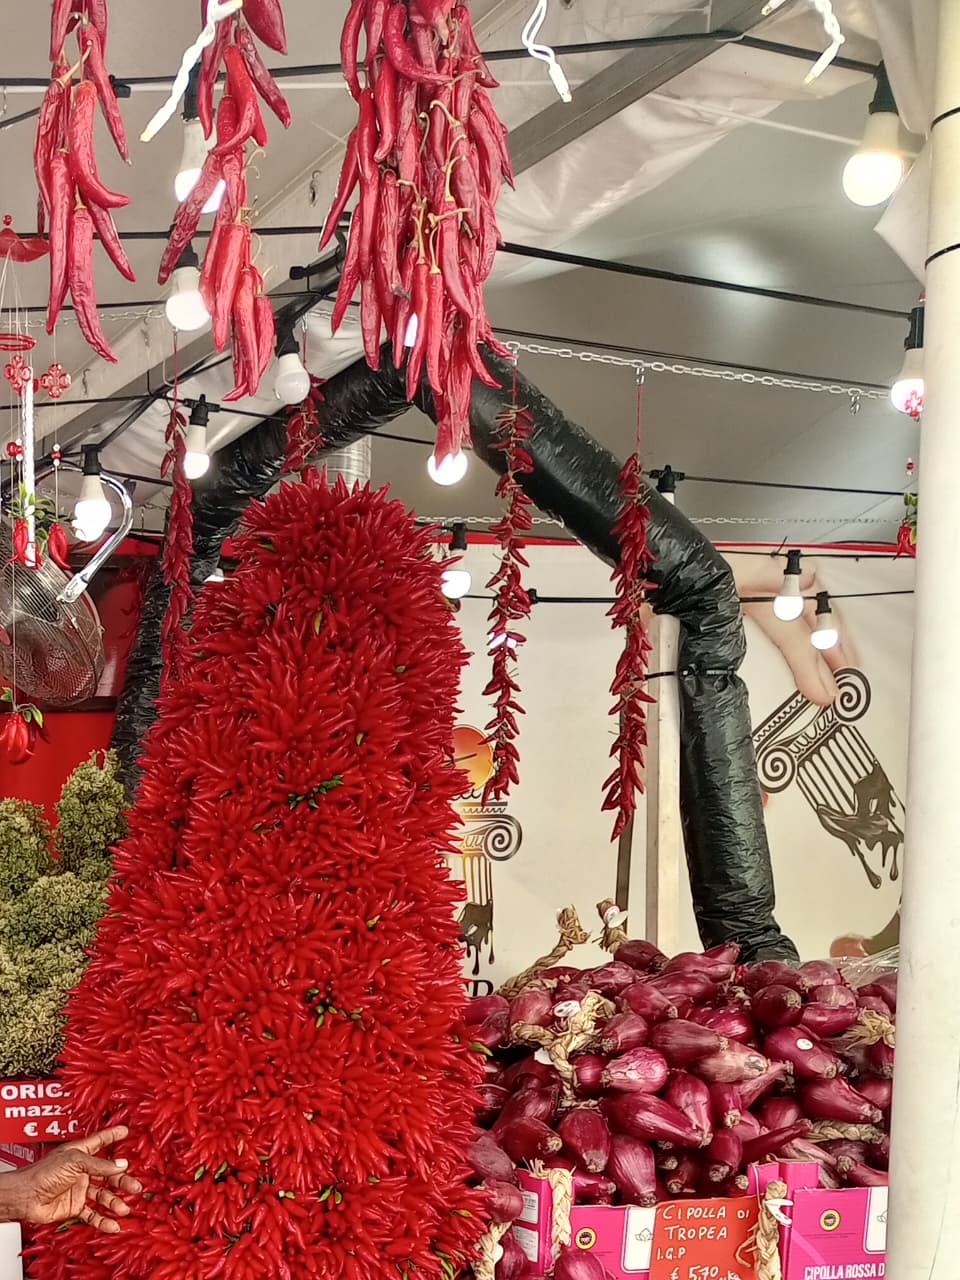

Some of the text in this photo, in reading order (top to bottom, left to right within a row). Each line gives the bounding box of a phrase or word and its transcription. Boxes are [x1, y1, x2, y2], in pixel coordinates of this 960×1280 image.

[5, 1105, 66, 1118] mazz
[24, 1122, 38, 1137] €
[663, 1205, 749, 1219] CIPOLLA DI
[664, 1225, 728, 1240] TROPEA
[805, 1265, 844, 1280] CIPOLLA
[845, 1263, 877, 1279] ROSSA
